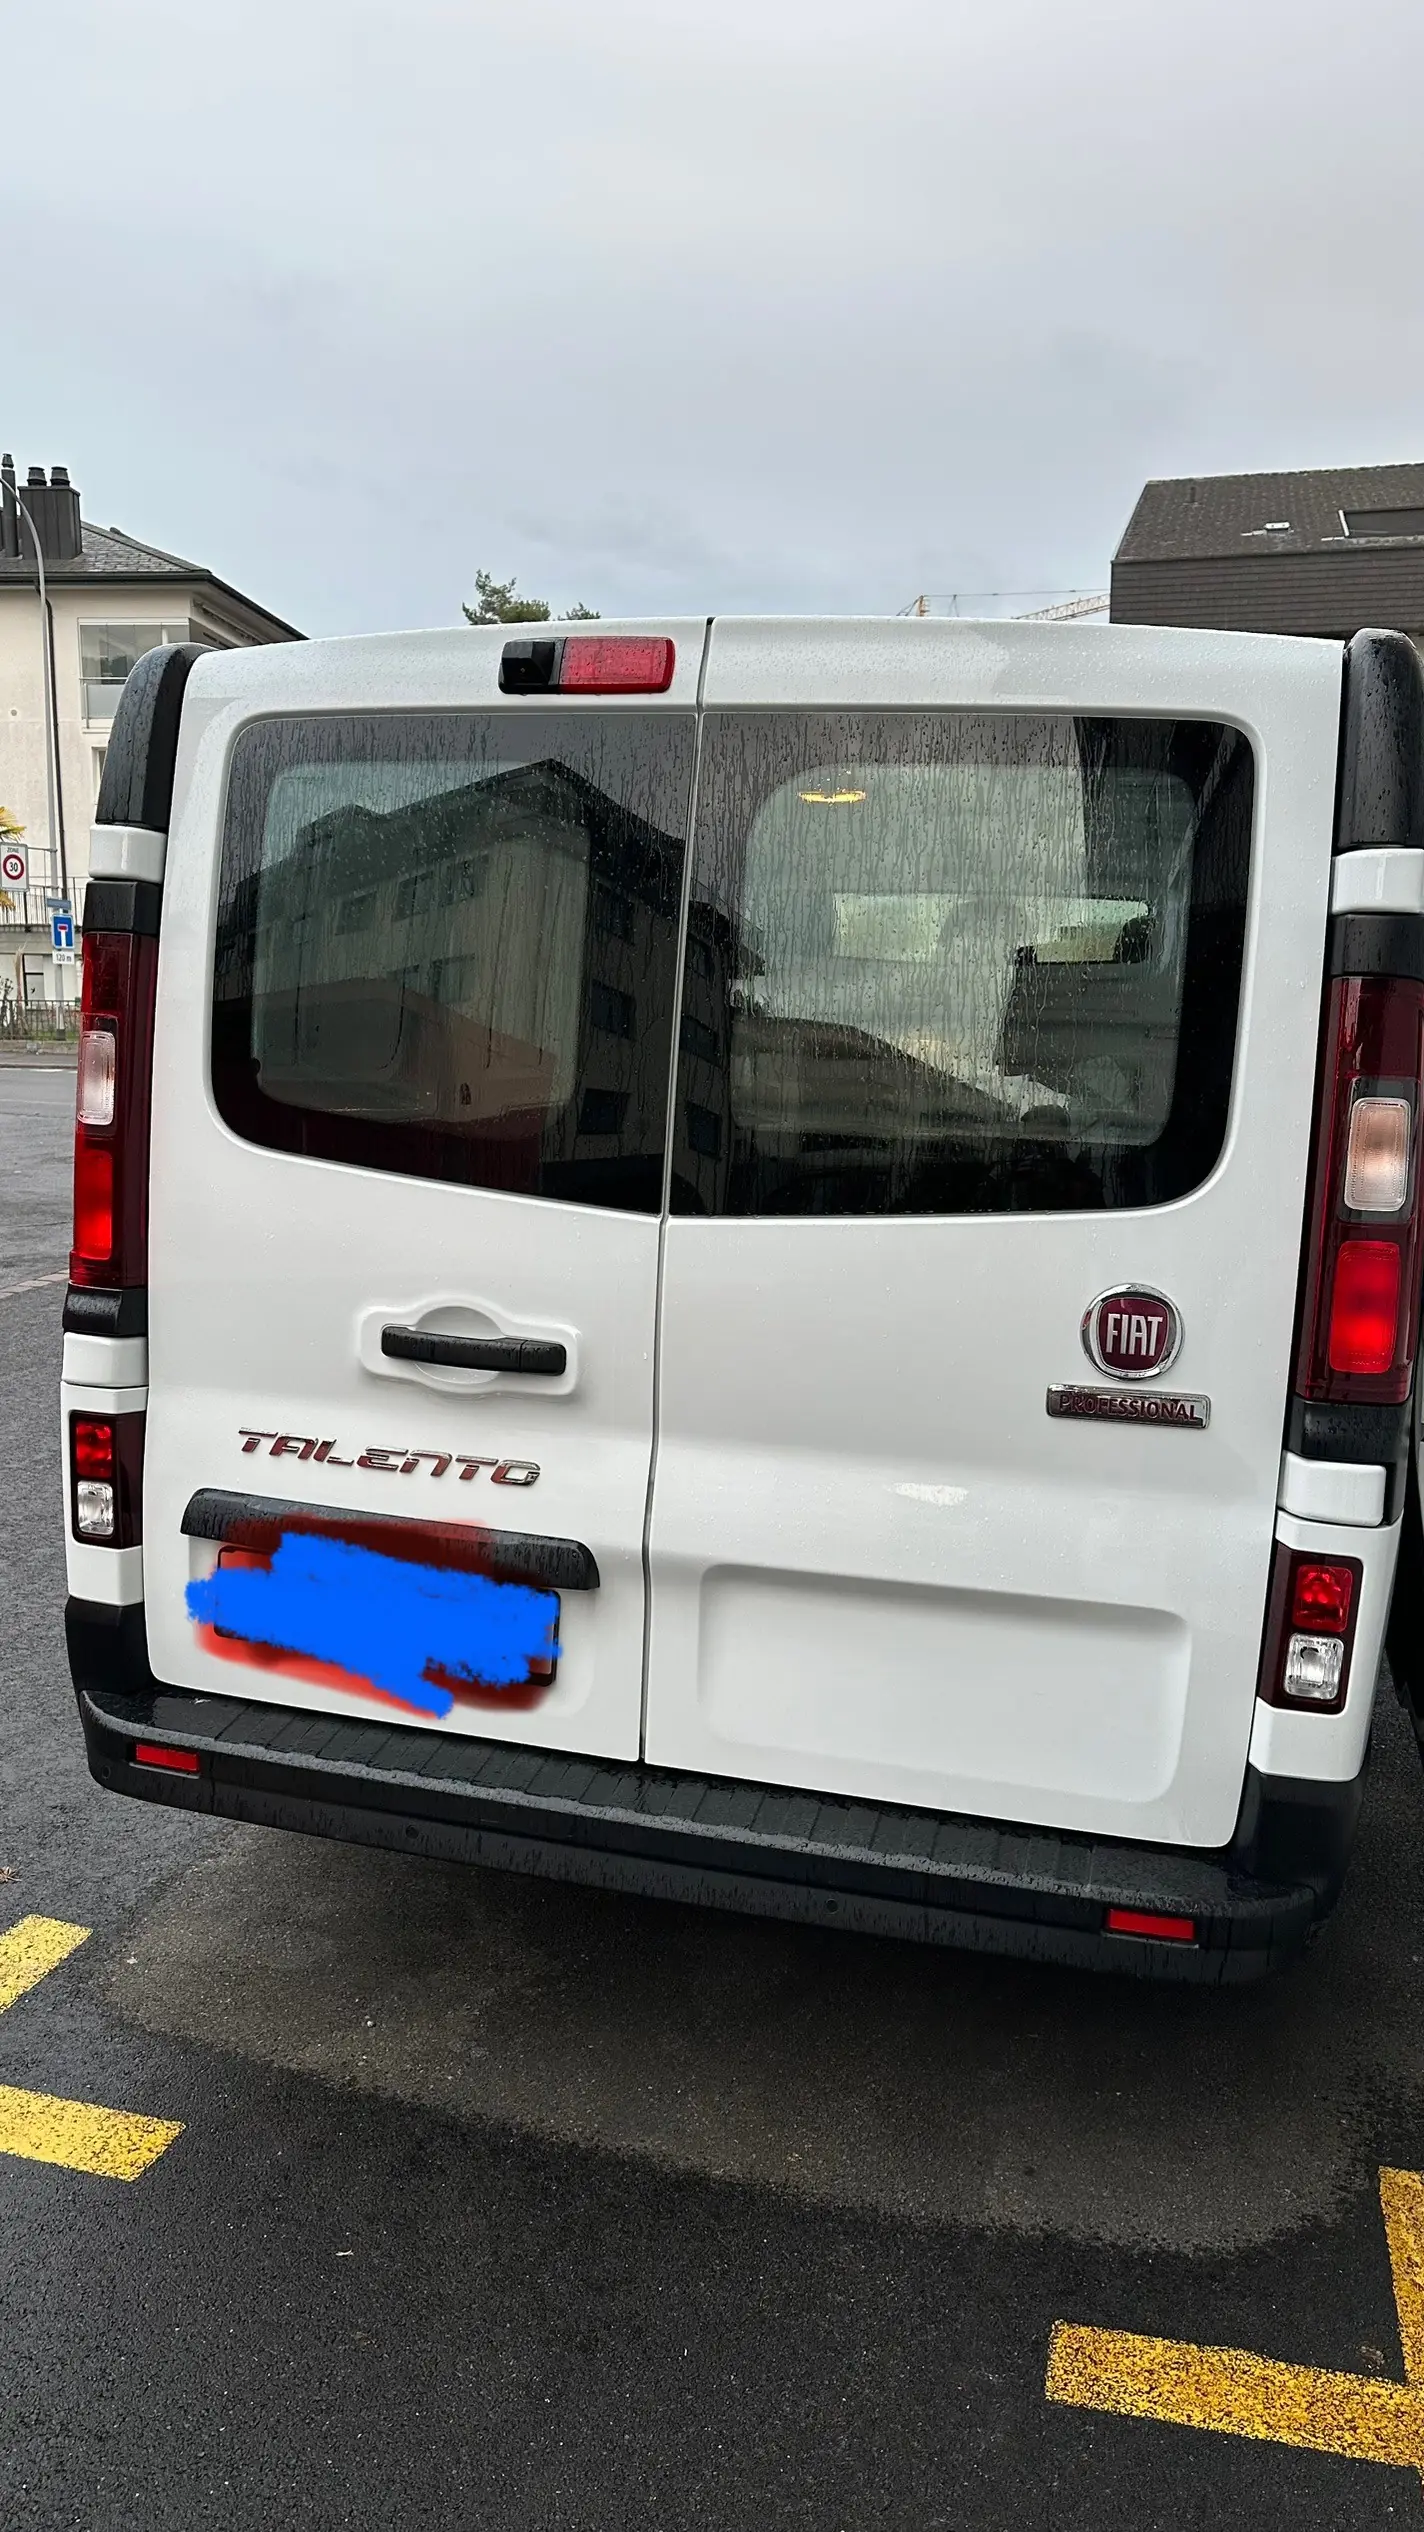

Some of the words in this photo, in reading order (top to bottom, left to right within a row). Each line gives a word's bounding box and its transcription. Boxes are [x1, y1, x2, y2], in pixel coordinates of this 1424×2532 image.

[9, 862, 18, 872] 30
[1105, 1313, 1163, 1357] FIAT
[1058, 1394, 1198, 1422] PROFESSIONAL
[238, 1427, 541, 1486] TALENTO
